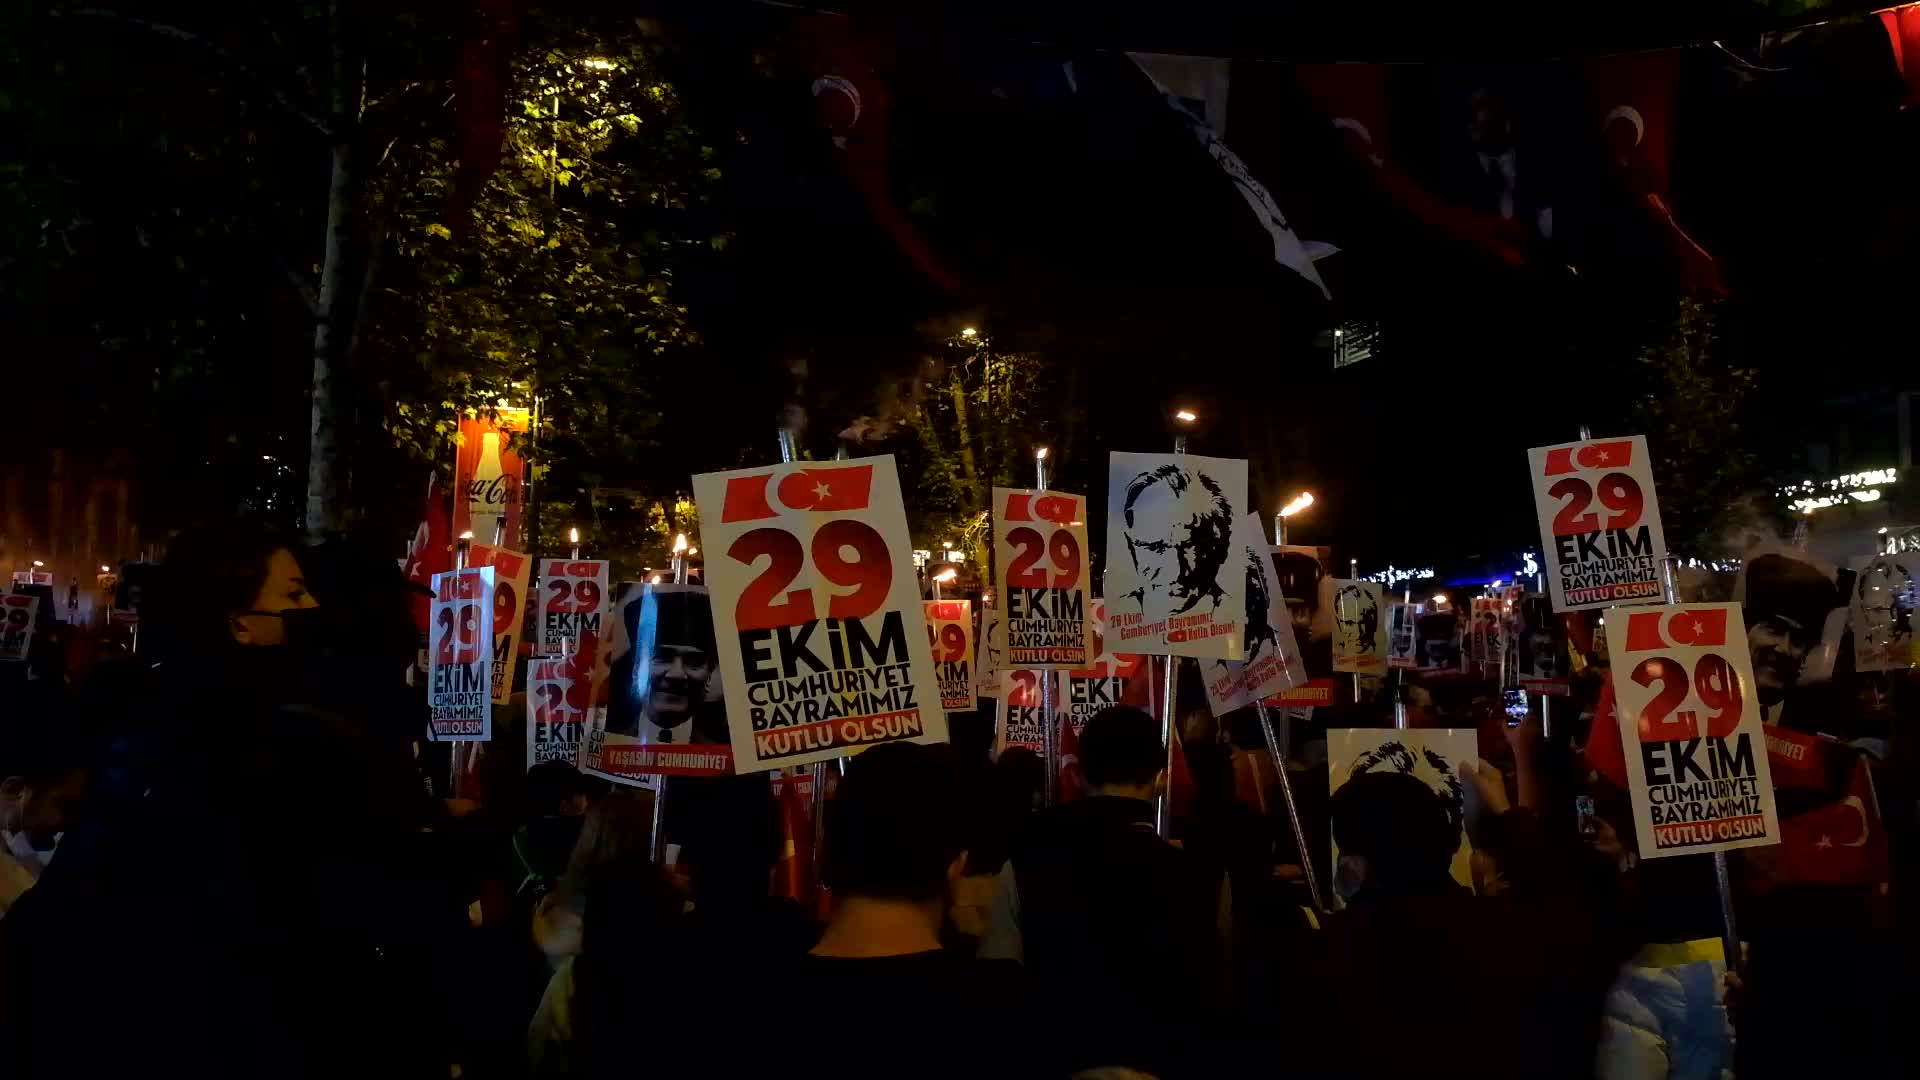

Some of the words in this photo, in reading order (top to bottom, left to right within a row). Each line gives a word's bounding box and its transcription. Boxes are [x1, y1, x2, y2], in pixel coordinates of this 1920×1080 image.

[1548, 472, 1644, 537] 29
[727, 519, 892, 631] 29
[1005, 526, 1080, 590] 29
[547, 580, 600, 613] 29
[1561, 568, 1658, 591] BAYRAMIMIZ
[1566, 586, 1609, 606] KUTLU
[1613, 583, 1659, 598] OLSUN
[437, 604, 481, 664] 29
[927, 623, 966, 662] 9
[1008, 632, 1084, 647] BAYRAMIMIZ
[1010, 648, 1048, 663] KUTLU
[1051, 649, 1085, 662] OLSUN
[750, 684, 918, 731] BAYRAMIMIZ
[1630, 653, 1743, 742] 29
[451, 721, 482, 734] OLSUN
[757, 724, 833, 757] KUTLU
[840, 713, 920, 743] OLSUN
[1650, 795, 1762, 825] BAYRAMIMIZ
[1656, 824, 1713, 846] KUTLU
[1718, 818, 1764, 839] OLSUN
